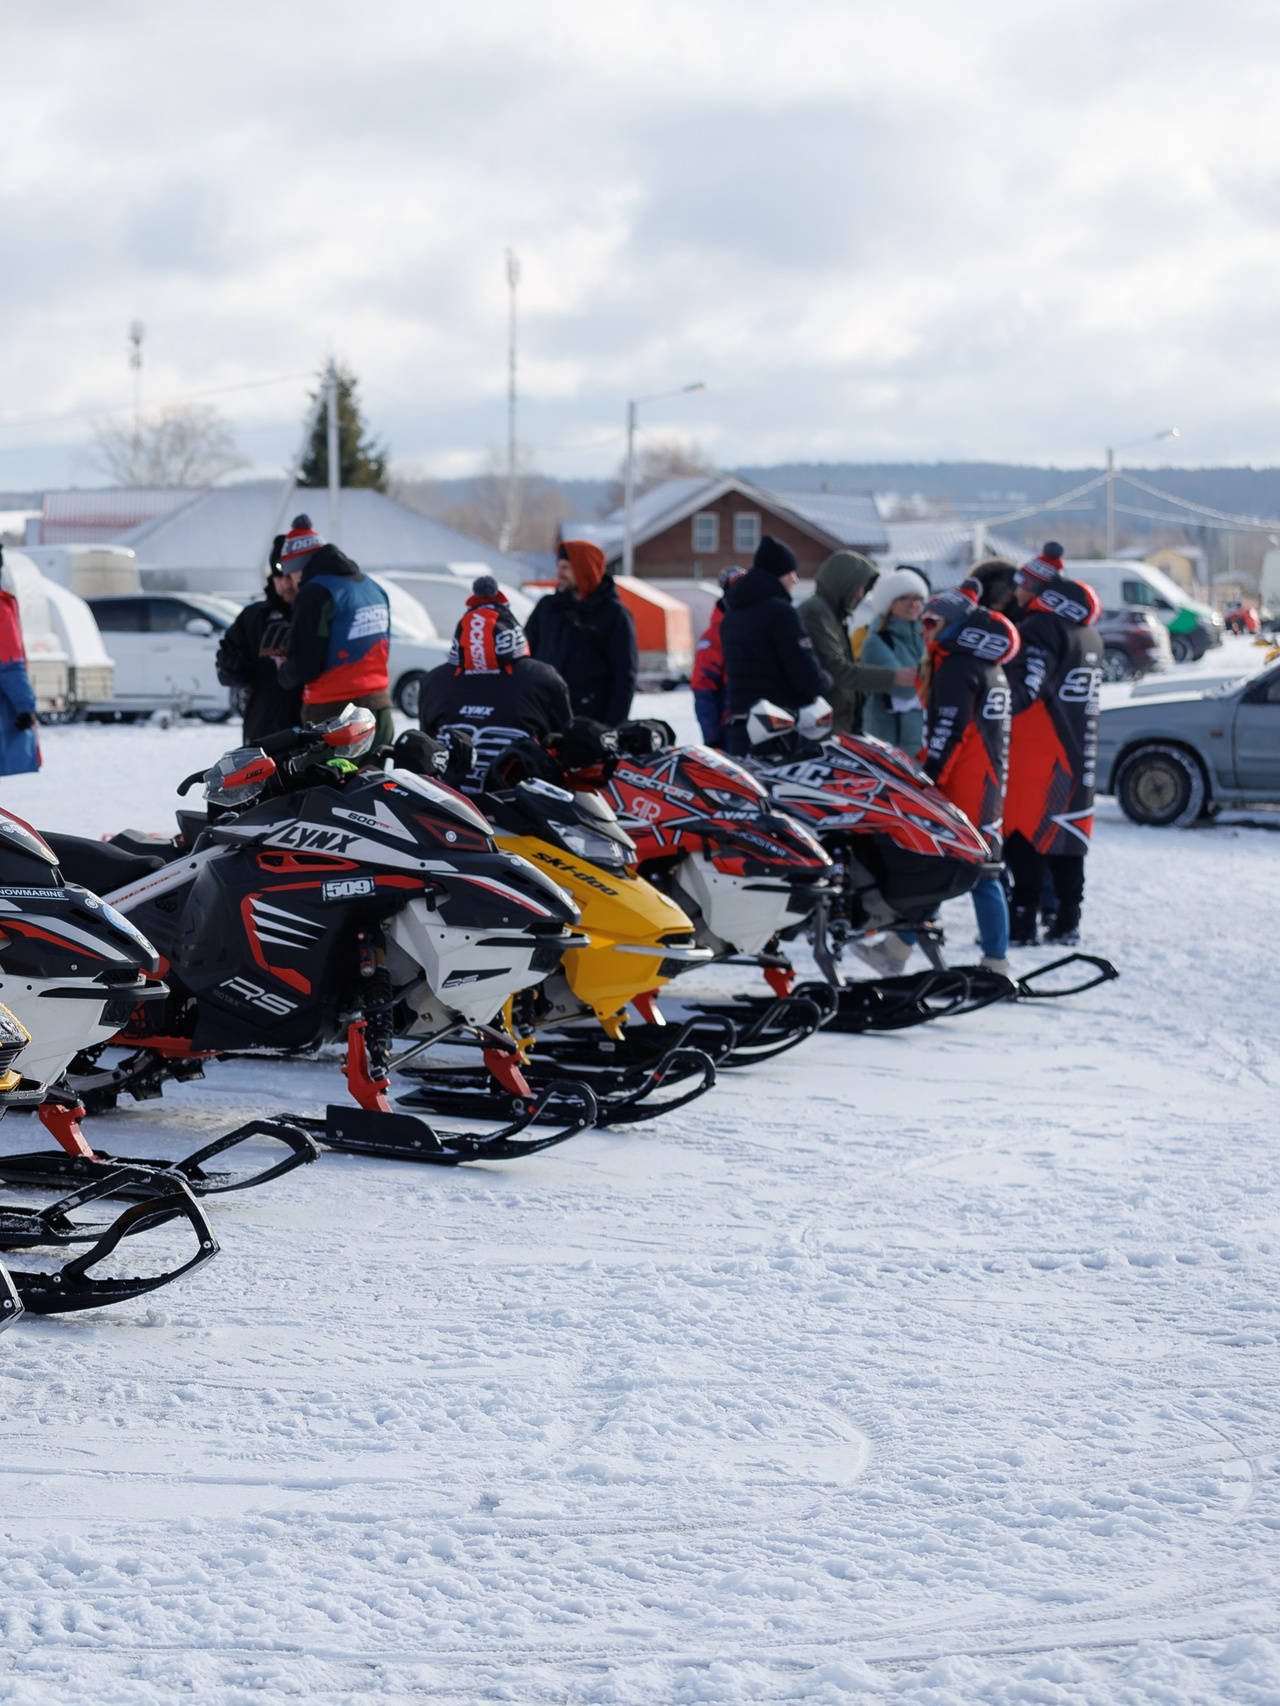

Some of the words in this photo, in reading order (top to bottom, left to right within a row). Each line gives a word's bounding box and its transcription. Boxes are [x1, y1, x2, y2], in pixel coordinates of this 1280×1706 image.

[1041, 589, 1089, 621] 32
[957, 626, 1010, 658] 32
[245, 768, 264, 780] LYNX
[618, 768, 696, 801] DOCTOR
[713, 810, 760, 821] LYNX
[277, 826, 362, 854] LYNX
[326, 880, 373, 897] 509
[531, 851, 620, 896] ski-doo
[219, 975, 299, 1016] RS
